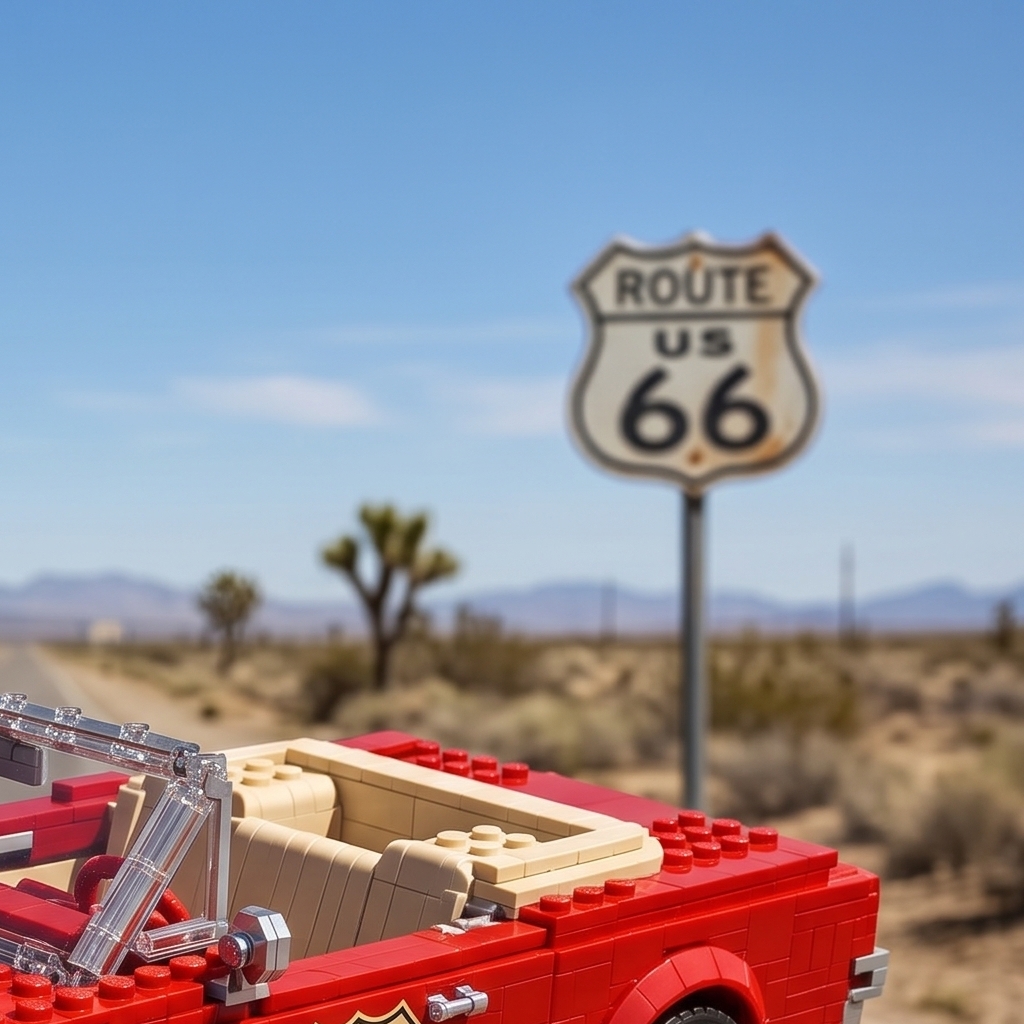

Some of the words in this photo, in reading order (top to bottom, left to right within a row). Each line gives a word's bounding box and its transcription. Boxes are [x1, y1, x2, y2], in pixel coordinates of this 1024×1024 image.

[615, 265, 771, 305] ROUTE
[654, 327, 733, 359] US
[619, 363, 771, 454] 66
